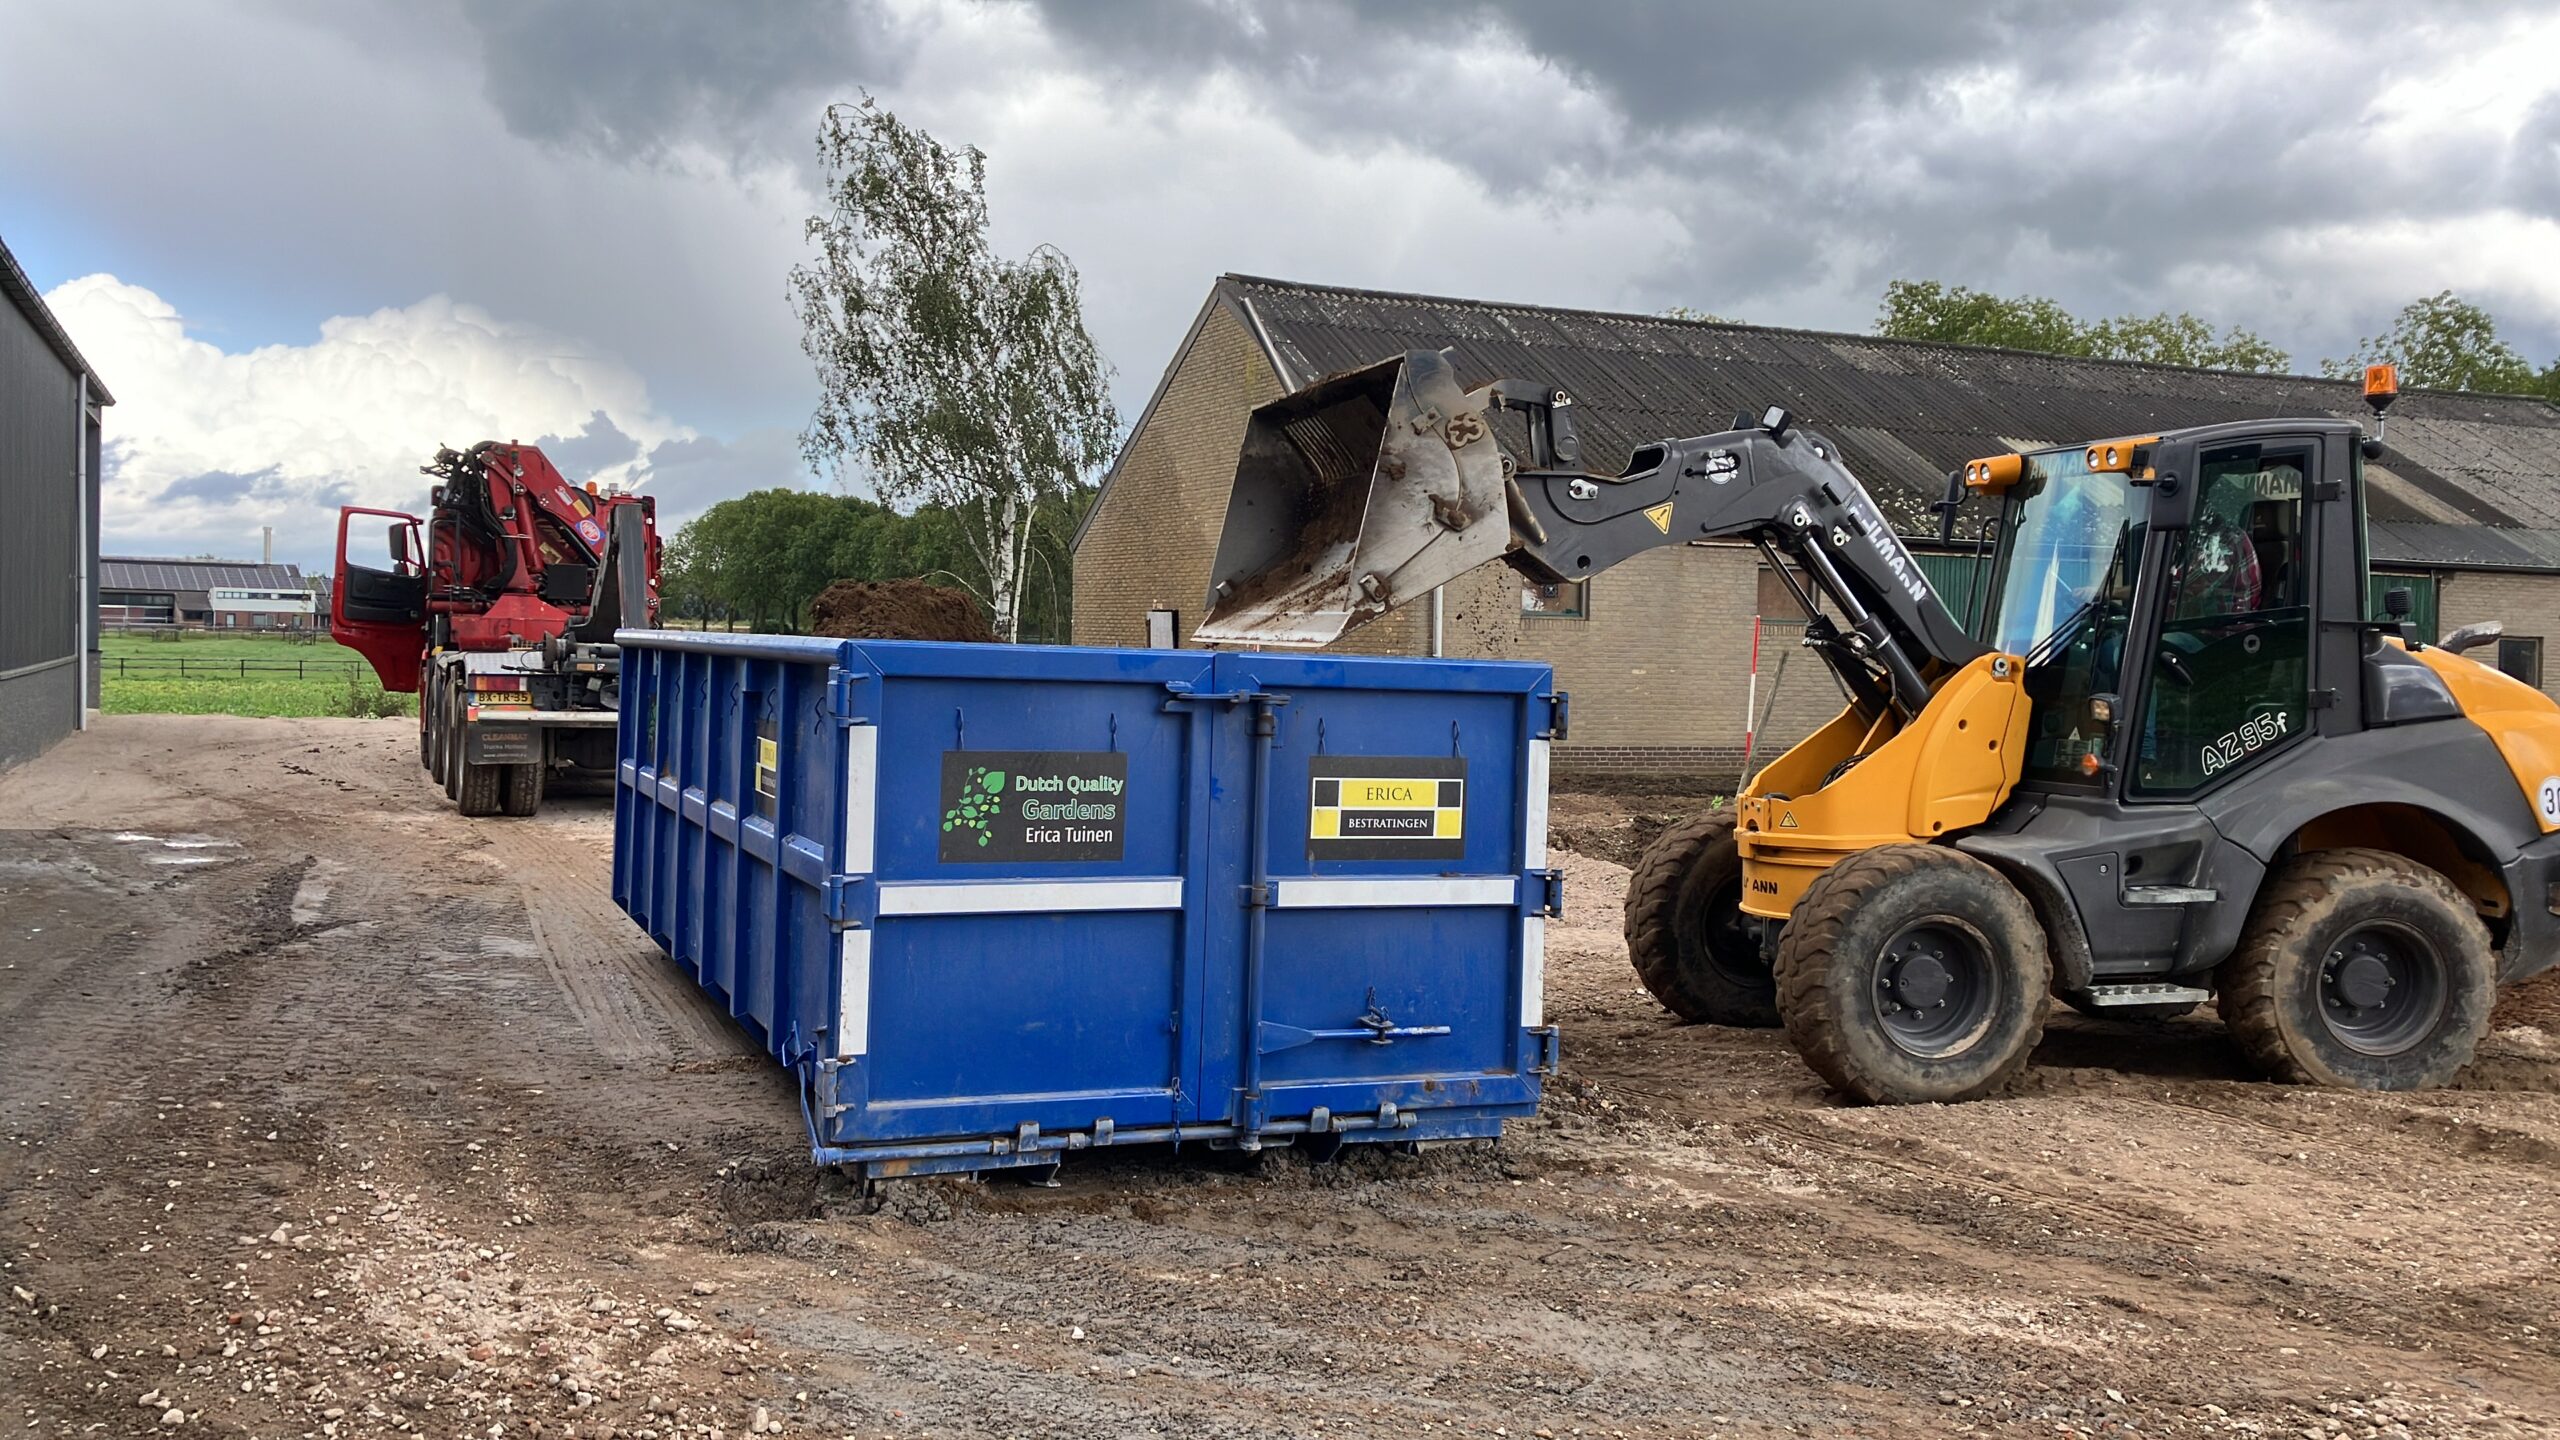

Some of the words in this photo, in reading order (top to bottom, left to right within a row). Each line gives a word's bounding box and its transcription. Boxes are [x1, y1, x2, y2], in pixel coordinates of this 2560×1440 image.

[1015, 774, 1064, 792] Dutch
[1067, 774, 1124, 796] Quality
[1366, 787, 1413, 801] ERICA
[1022, 798, 1116, 820] Gardens
[1348, 818, 1428, 829] BESTRATINGEN
[1025, 826, 1061, 843] Erica
[1065, 826, 1113, 843] Tuinen
